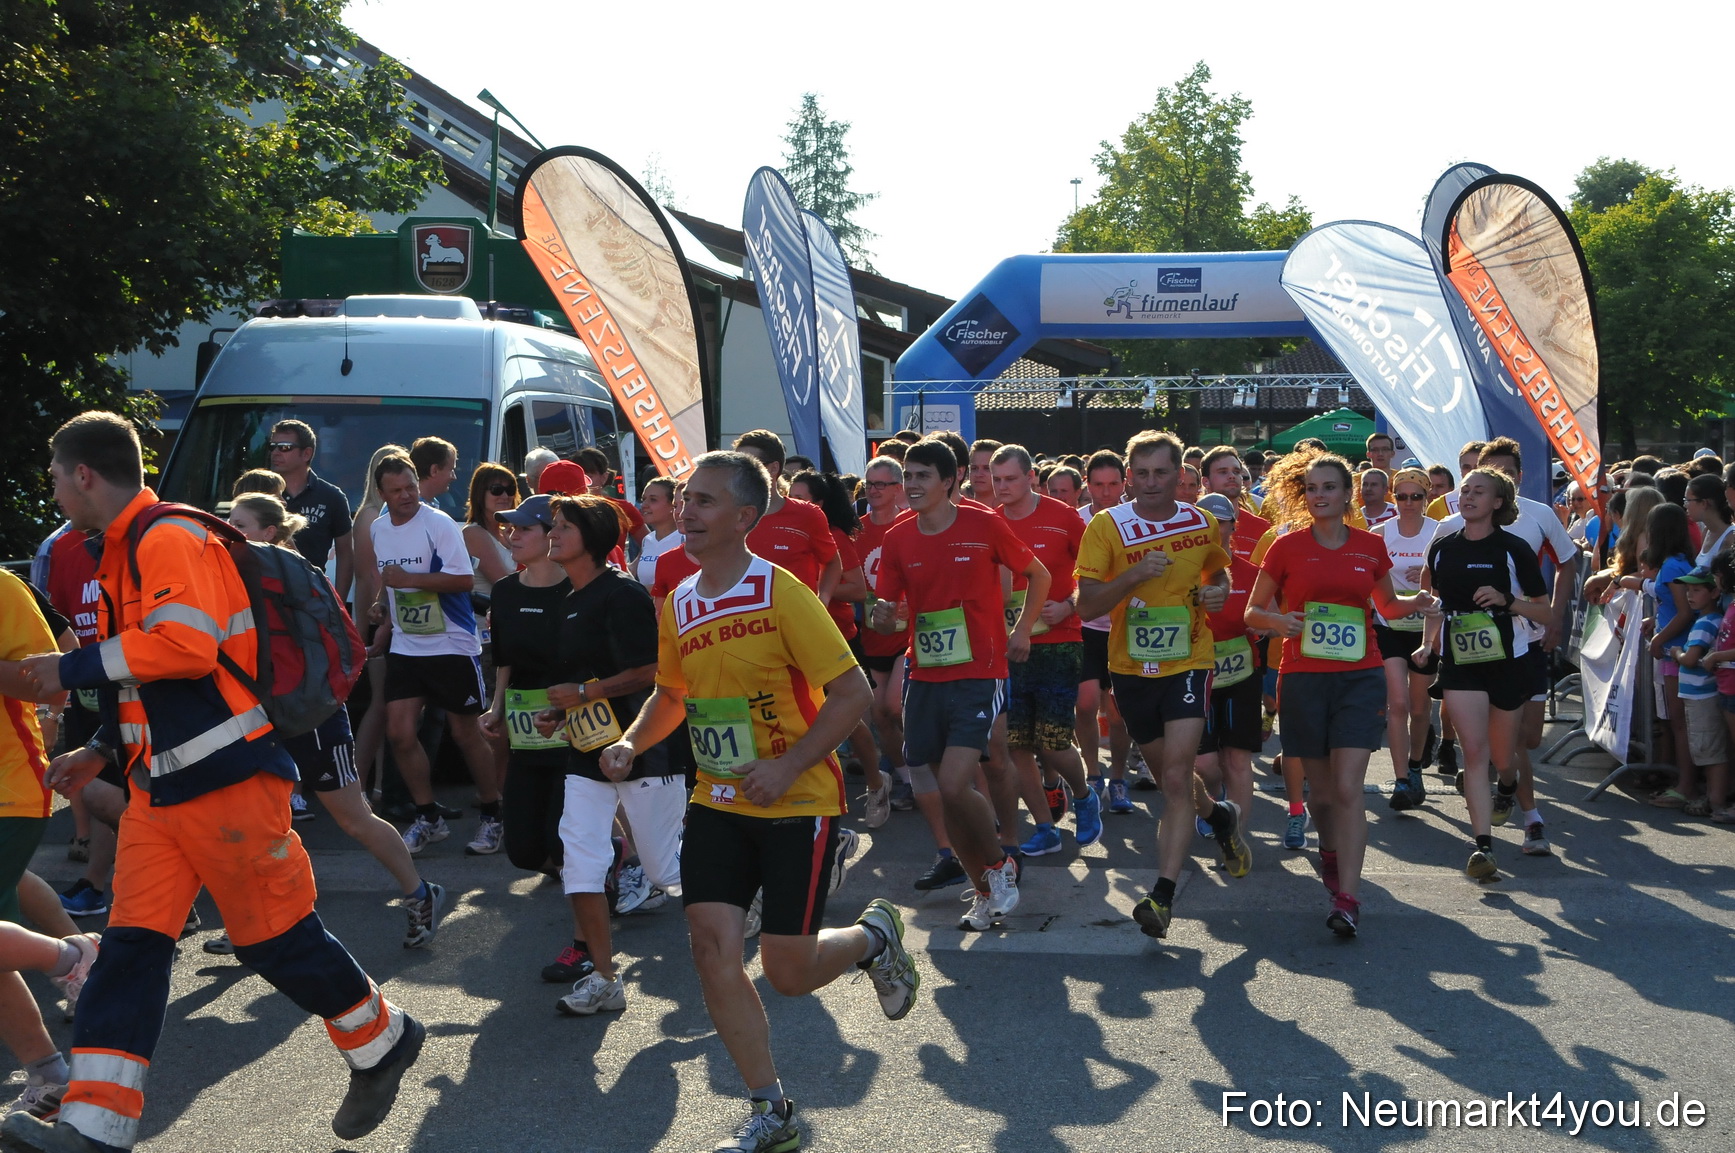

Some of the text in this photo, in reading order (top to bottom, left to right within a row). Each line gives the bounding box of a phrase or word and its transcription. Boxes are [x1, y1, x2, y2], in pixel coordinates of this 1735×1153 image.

[431, 277, 456, 288] 1628
[1167, 276, 1200, 284] Fischer
[1141, 292, 1240, 312] firmenlauf
[1141, 312, 1182, 320] neumarkt
[956, 328, 1008, 339] Fischer
[1171, 534, 1211, 552] BÖGL
[378, 556, 423, 568] DELPHI
[400, 605, 431, 624] 227
[680, 618, 778, 661] MAX BÖGL
[918, 629, 957, 654] 937
[1135, 627, 1180, 649] 827
[1311, 622, 1357, 647] 936
[1455, 630, 1493, 652] 976
[567, 702, 612, 739] 1110
[691, 726, 740, 759] 801
